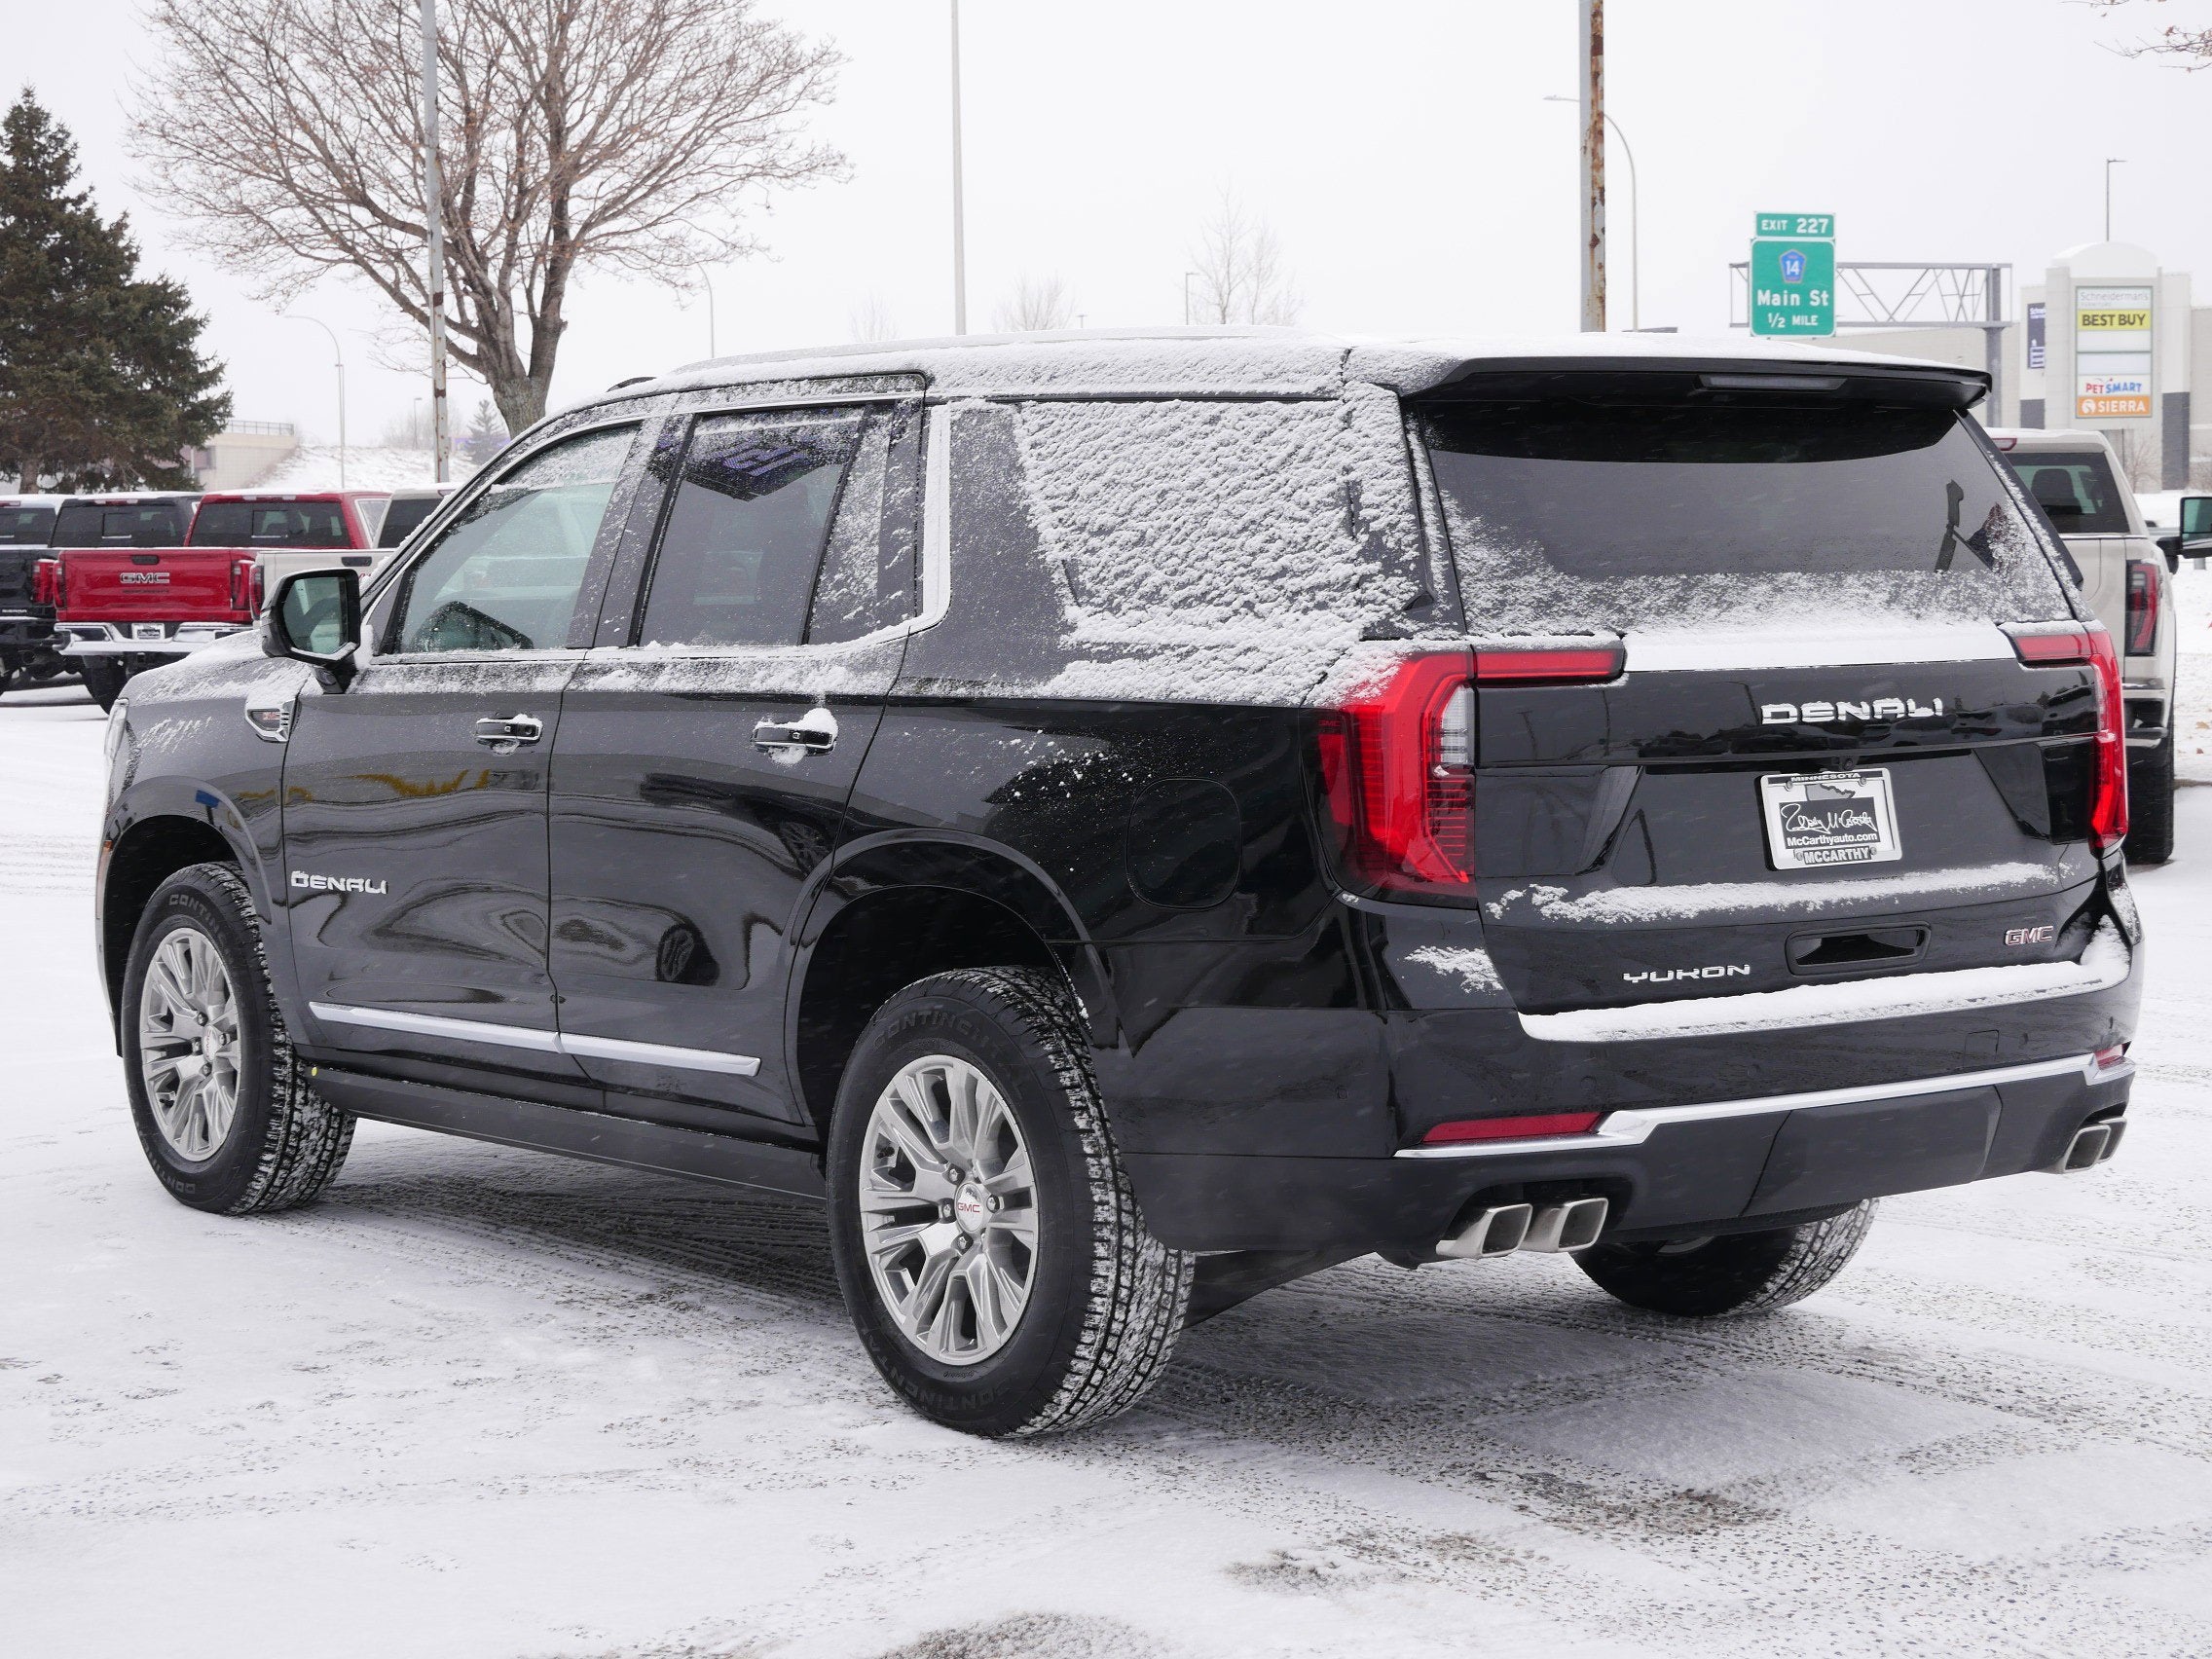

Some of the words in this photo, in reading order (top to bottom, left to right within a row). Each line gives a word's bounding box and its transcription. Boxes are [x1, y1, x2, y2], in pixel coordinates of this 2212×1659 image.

[1761, 220, 1788, 230] EXIT
[1796, 218, 1828, 234] 227
[1786, 260, 1800, 276] 14
[1757, 289, 1800, 306] Main
[1809, 289, 1828, 306] St
[1791, 315, 1819, 325] MILE
[2082, 314, 2115, 326] BEST
[2119, 313, 2146, 325] BUY
[2098, 400, 2146, 413] SIERRA
[120, 572, 170, 583] GMC
[1761, 697, 1943, 724] DENALI
[1791, 772, 1861, 781] MINNESOTA
[1787, 832, 1878, 847] McCarthyauto.com
[1805, 847, 1869, 864] MCCARTHY
[291, 870, 387, 894] DENALI
[2005, 926, 2053, 945] GMC
[1623, 964, 1751, 983] YUKON
[958, 1202, 980, 1213] GMC
